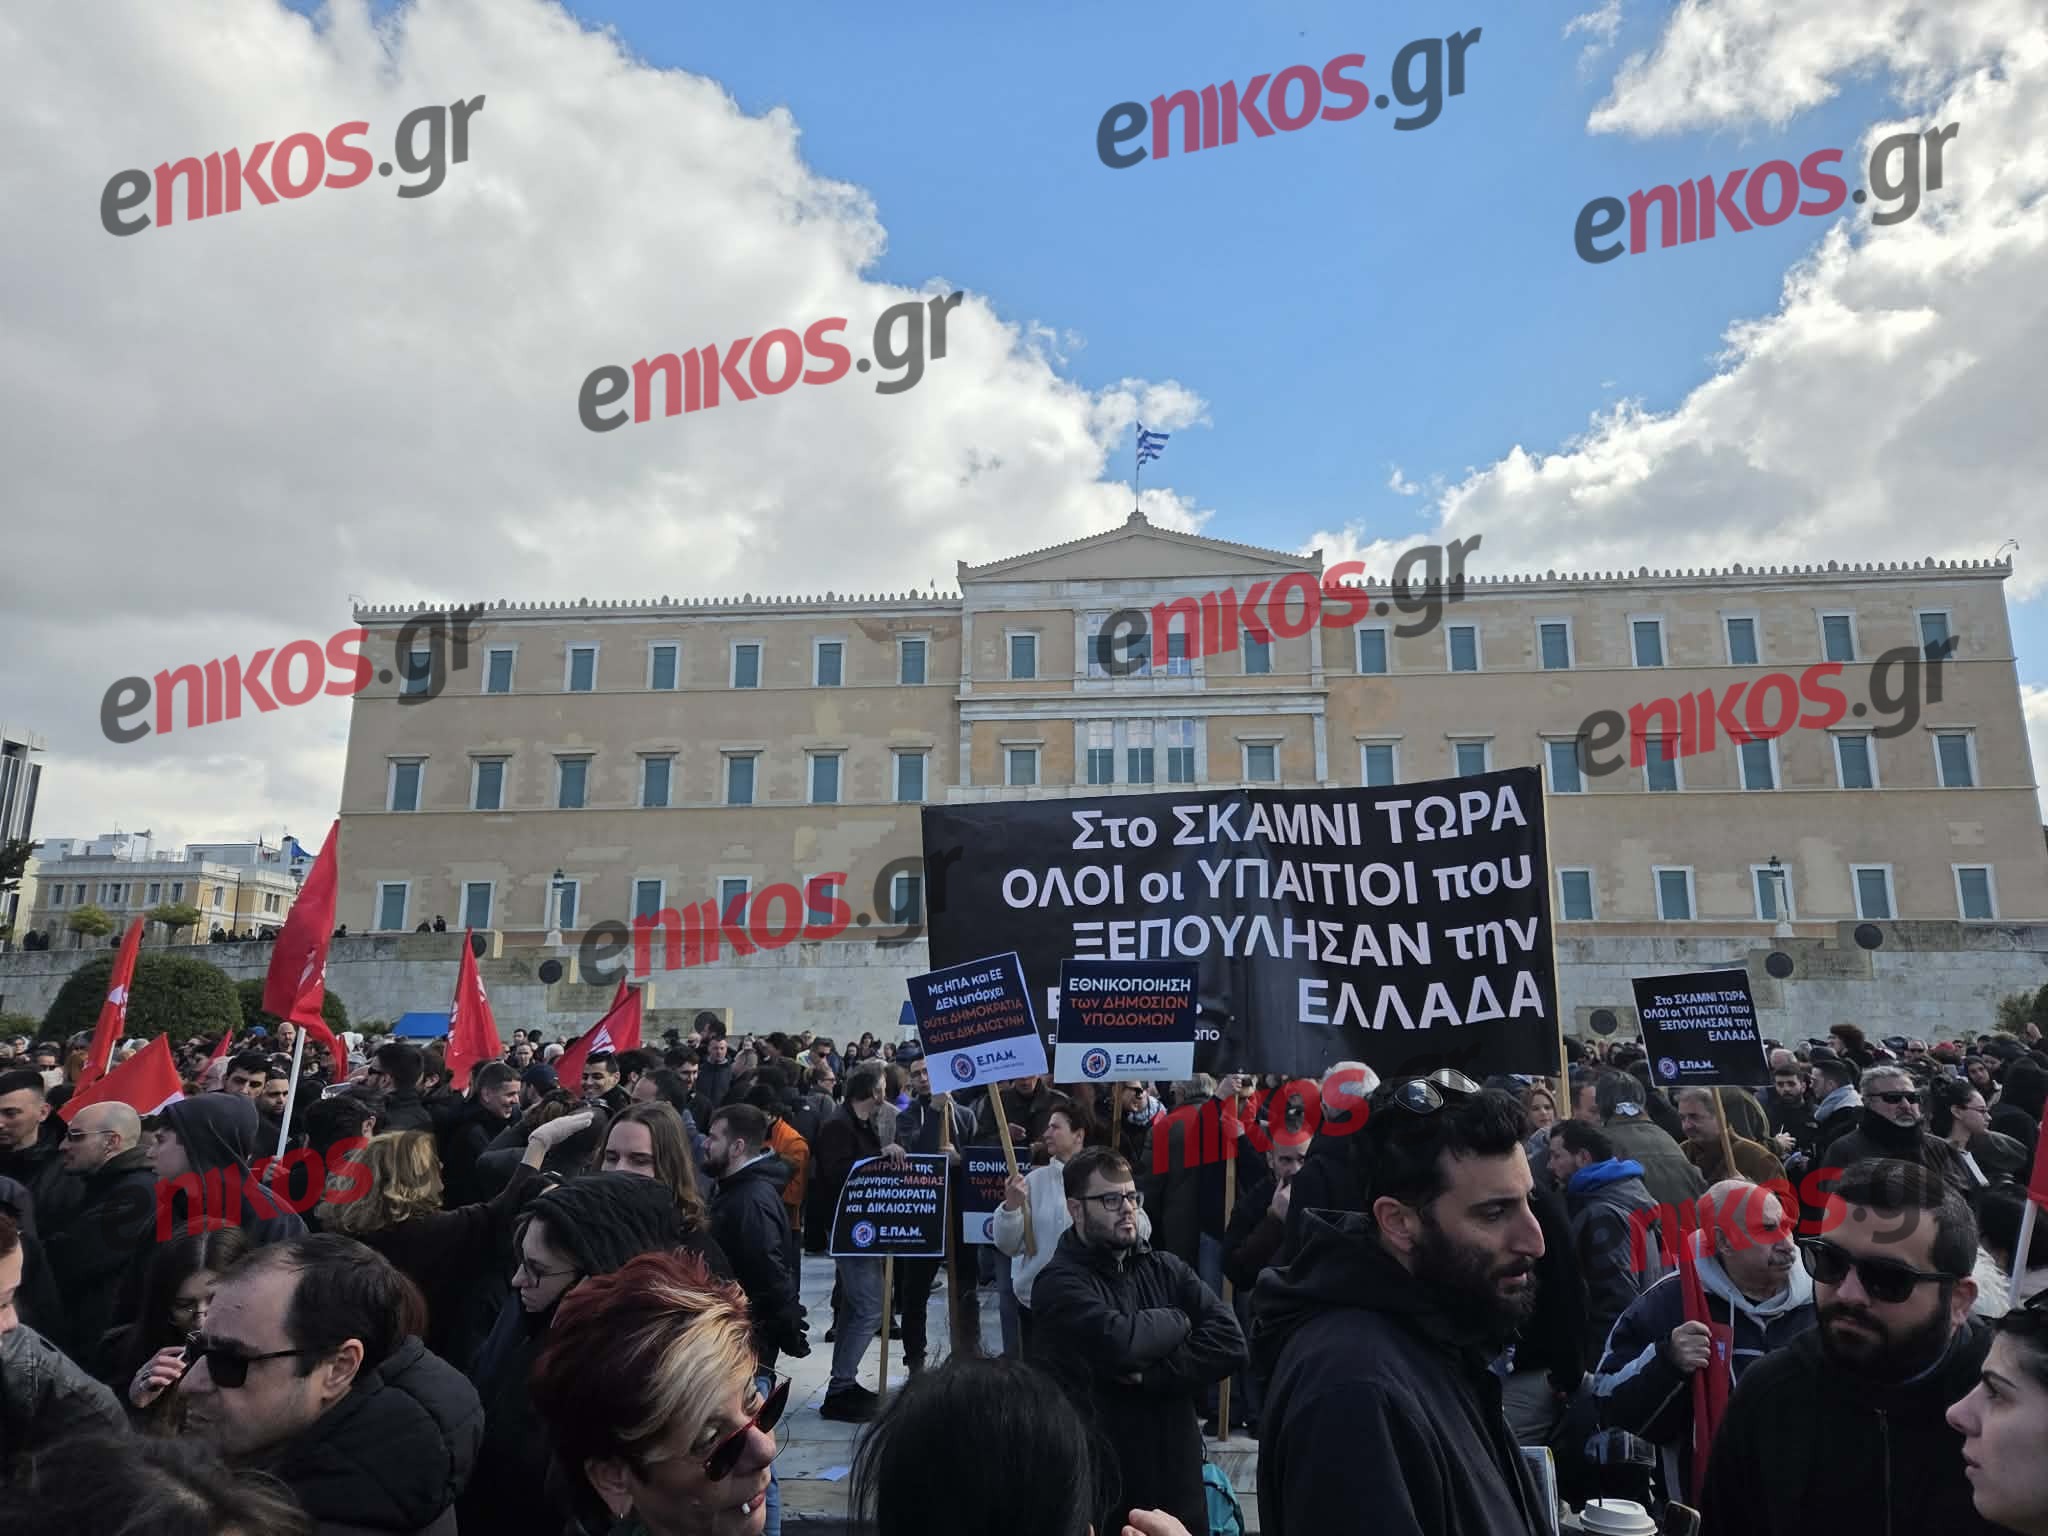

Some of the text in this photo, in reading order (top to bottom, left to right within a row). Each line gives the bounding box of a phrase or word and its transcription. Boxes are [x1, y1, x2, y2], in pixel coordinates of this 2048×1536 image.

[1071, 785, 1528, 850] Στο ΣΚΑΜΝΙ ΤΩΡΑ
[1002, 854, 1533, 909] ΟΛΟΙ οι ΥΠΑΙΤΙΟΙ που
[1072, 914, 1539, 967] ΞΕΠΟΥΛΗΣΑΝ την
[927, 968, 1004, 996] Με ΗΠΑ και ΕΕ
[1069, 977, 1191, 993] ΕΘΝΙΚΟΠΟΙΗΣΗ
[935, 986, 1005, 1010] ΔΕΝ υπάρχει
[1070, 998, 1100, 1009] των
[1103, 995, 1189, 1009] ΔΗΜΟΣΙΩΝ
[1298, 970, 1546, 1031] ΕΛΛΑΔΑ
[1653, 990, 1747, 1006] Στο ΣΚΑΜΝΙ ΤΩΡΑ
[949, 998, 1024, 1024] ΔΗΜΟΚΡΑΤΙΑ
[1643, 1004, 1750, 1019] ΟΛΟΙ οι ΥΠΑΙΤΙΟΙ που
[957, 1015, 1026, 1037] ΔΙΚΑΙΟΣΥΝΗ
[1081, 1013, 1176, 1026] ΥΠΟΔΟΜΩΝ
[1659, 1018, 1753, 1031] ΞΕΠΟΥΛΗΣΑΝ την
[1707, 1030, 1756, 1042] ΕΛΛΑΔΑ
[914, 1163, 934, 1174] της
[865, 1188, 937, 1200] ΔΗΜΟΚΡΑΤΙΑ
[867, 1202, 937, 1214] ΔΙΚΑΙΟΣΥΝΗ
